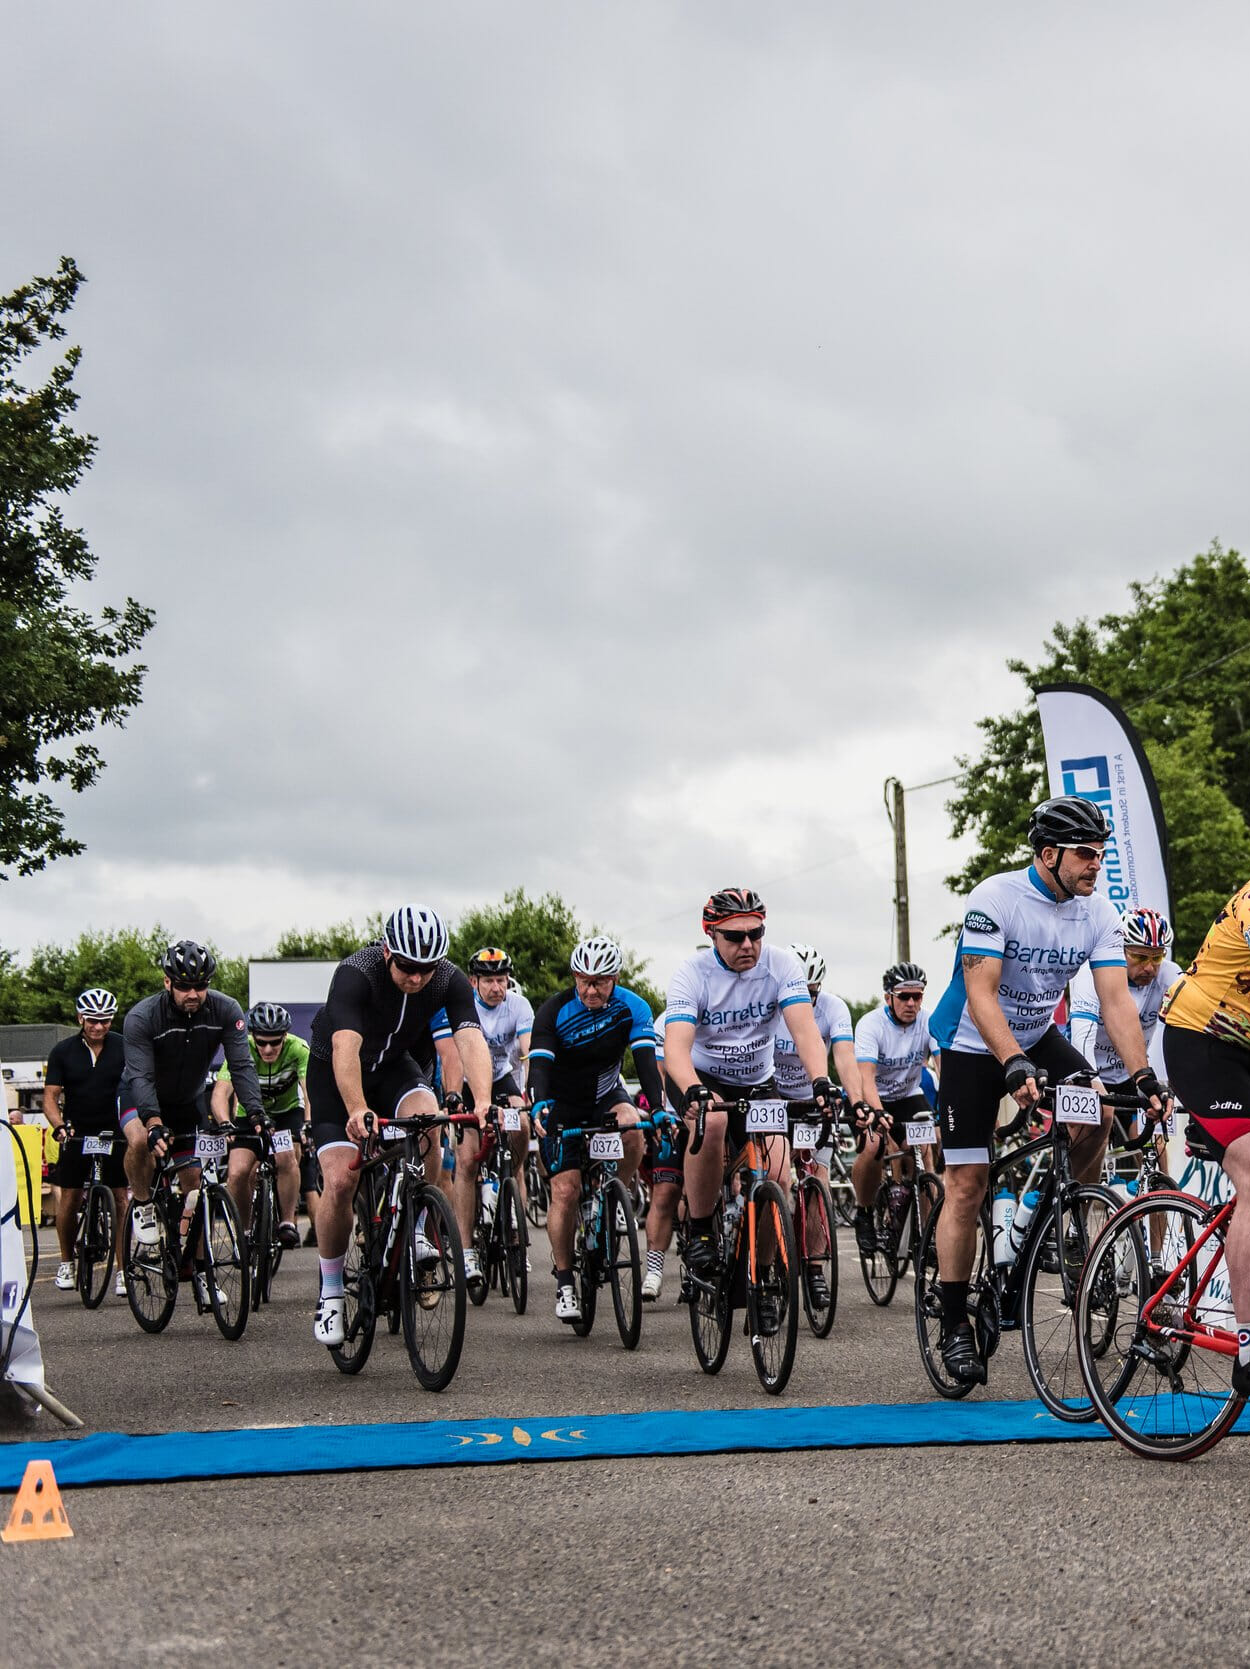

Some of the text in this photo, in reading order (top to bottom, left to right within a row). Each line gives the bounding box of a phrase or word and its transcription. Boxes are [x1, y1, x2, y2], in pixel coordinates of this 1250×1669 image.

[967, 912, 986, 923] LAND
[968, 921, 993, 932] ROVER
[1003, 940, 1086, 966] Barretts
[998, 984, 1061, 1004] Supportin
[701, 1000, 776, 1026] Barretts
[1008, 1016, 1051, 1031] harities
[724, 1052, 755, 1064] local
[709, 1062, 765, 1077] charities
[1062, 1095, 1097, 1115] 0323
[1221, 1101, 1243, 1111] dhb
[750, 1107, 785, 1124] 0319
[797, 1129, 818, 1143] 031
[908, 1126, 933, 1139] 0277
[200, 1138, 225, 1152] 0338
[592, 1140, 620, 1153] 0372
